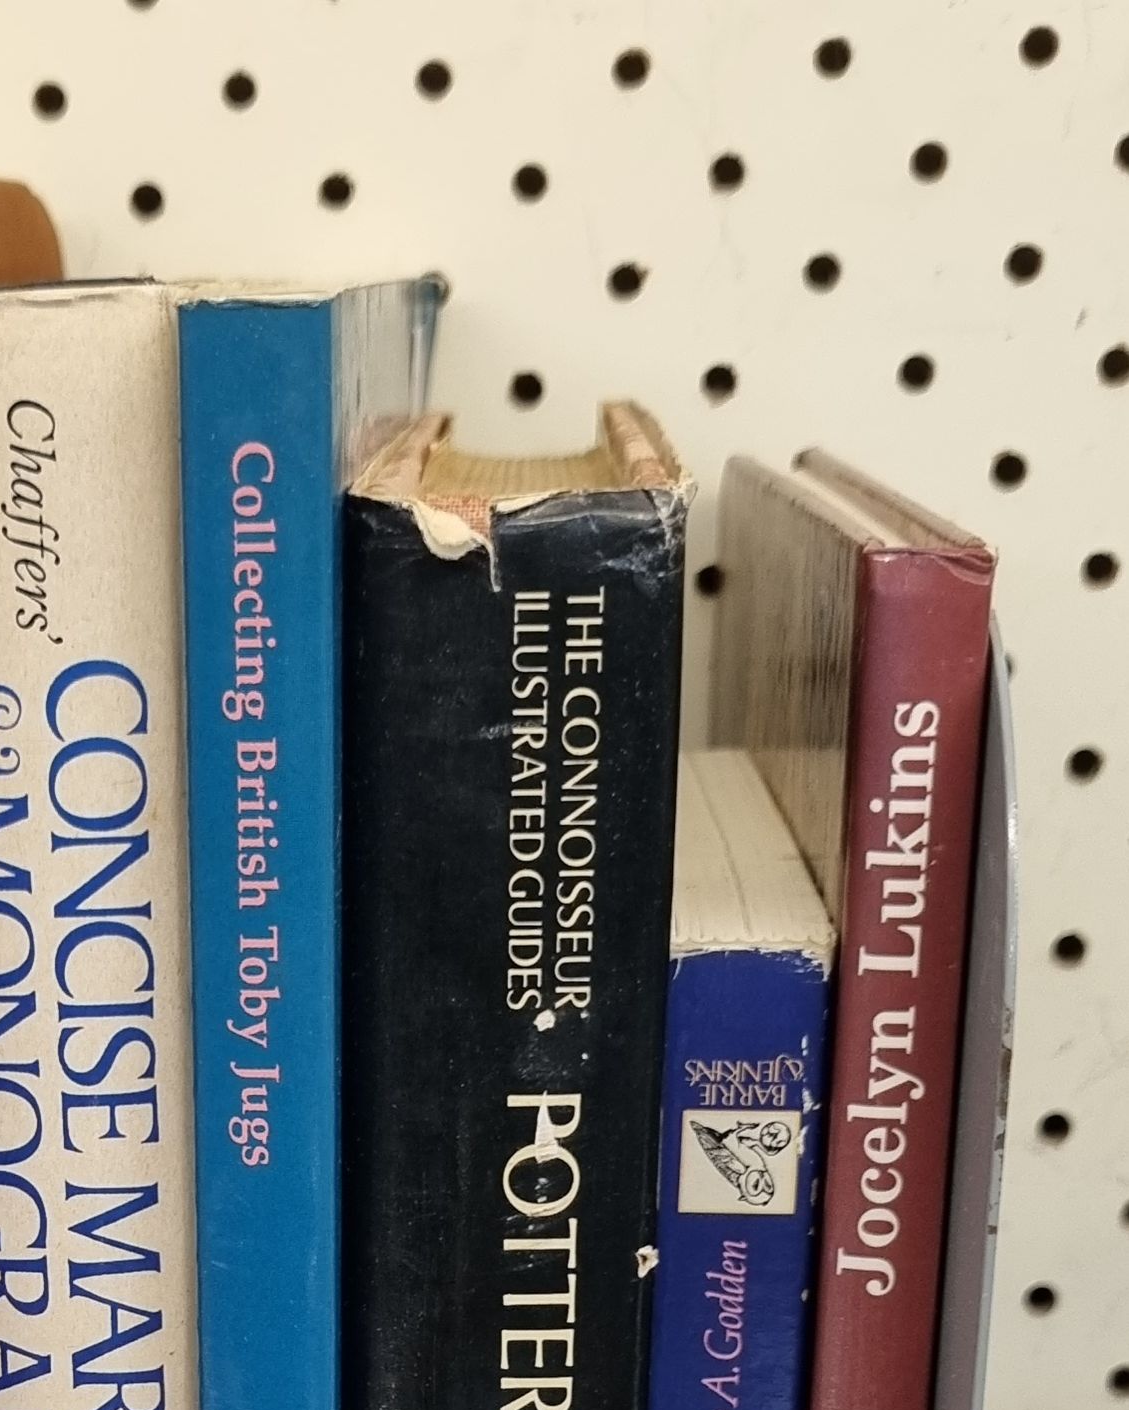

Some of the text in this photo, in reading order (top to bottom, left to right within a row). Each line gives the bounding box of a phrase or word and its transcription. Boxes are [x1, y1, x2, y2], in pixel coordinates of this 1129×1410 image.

[45, 659, 159, 1153] CONCISE
[221, 441, 282, 1168] Collecting British Toby Jugs
[506, 590, 552, 1011] ILLUSTRATED GUIDES
[554, 586, 605, 1010] THE CONNOISSEUR
[836, 700, 941, 1297] Jocelyn Lukins
[699, 1083, 788, 1107] BARRIE
[703, 1239, 748, 1361] Godden
[701, 1366, 741, 1408] A.
